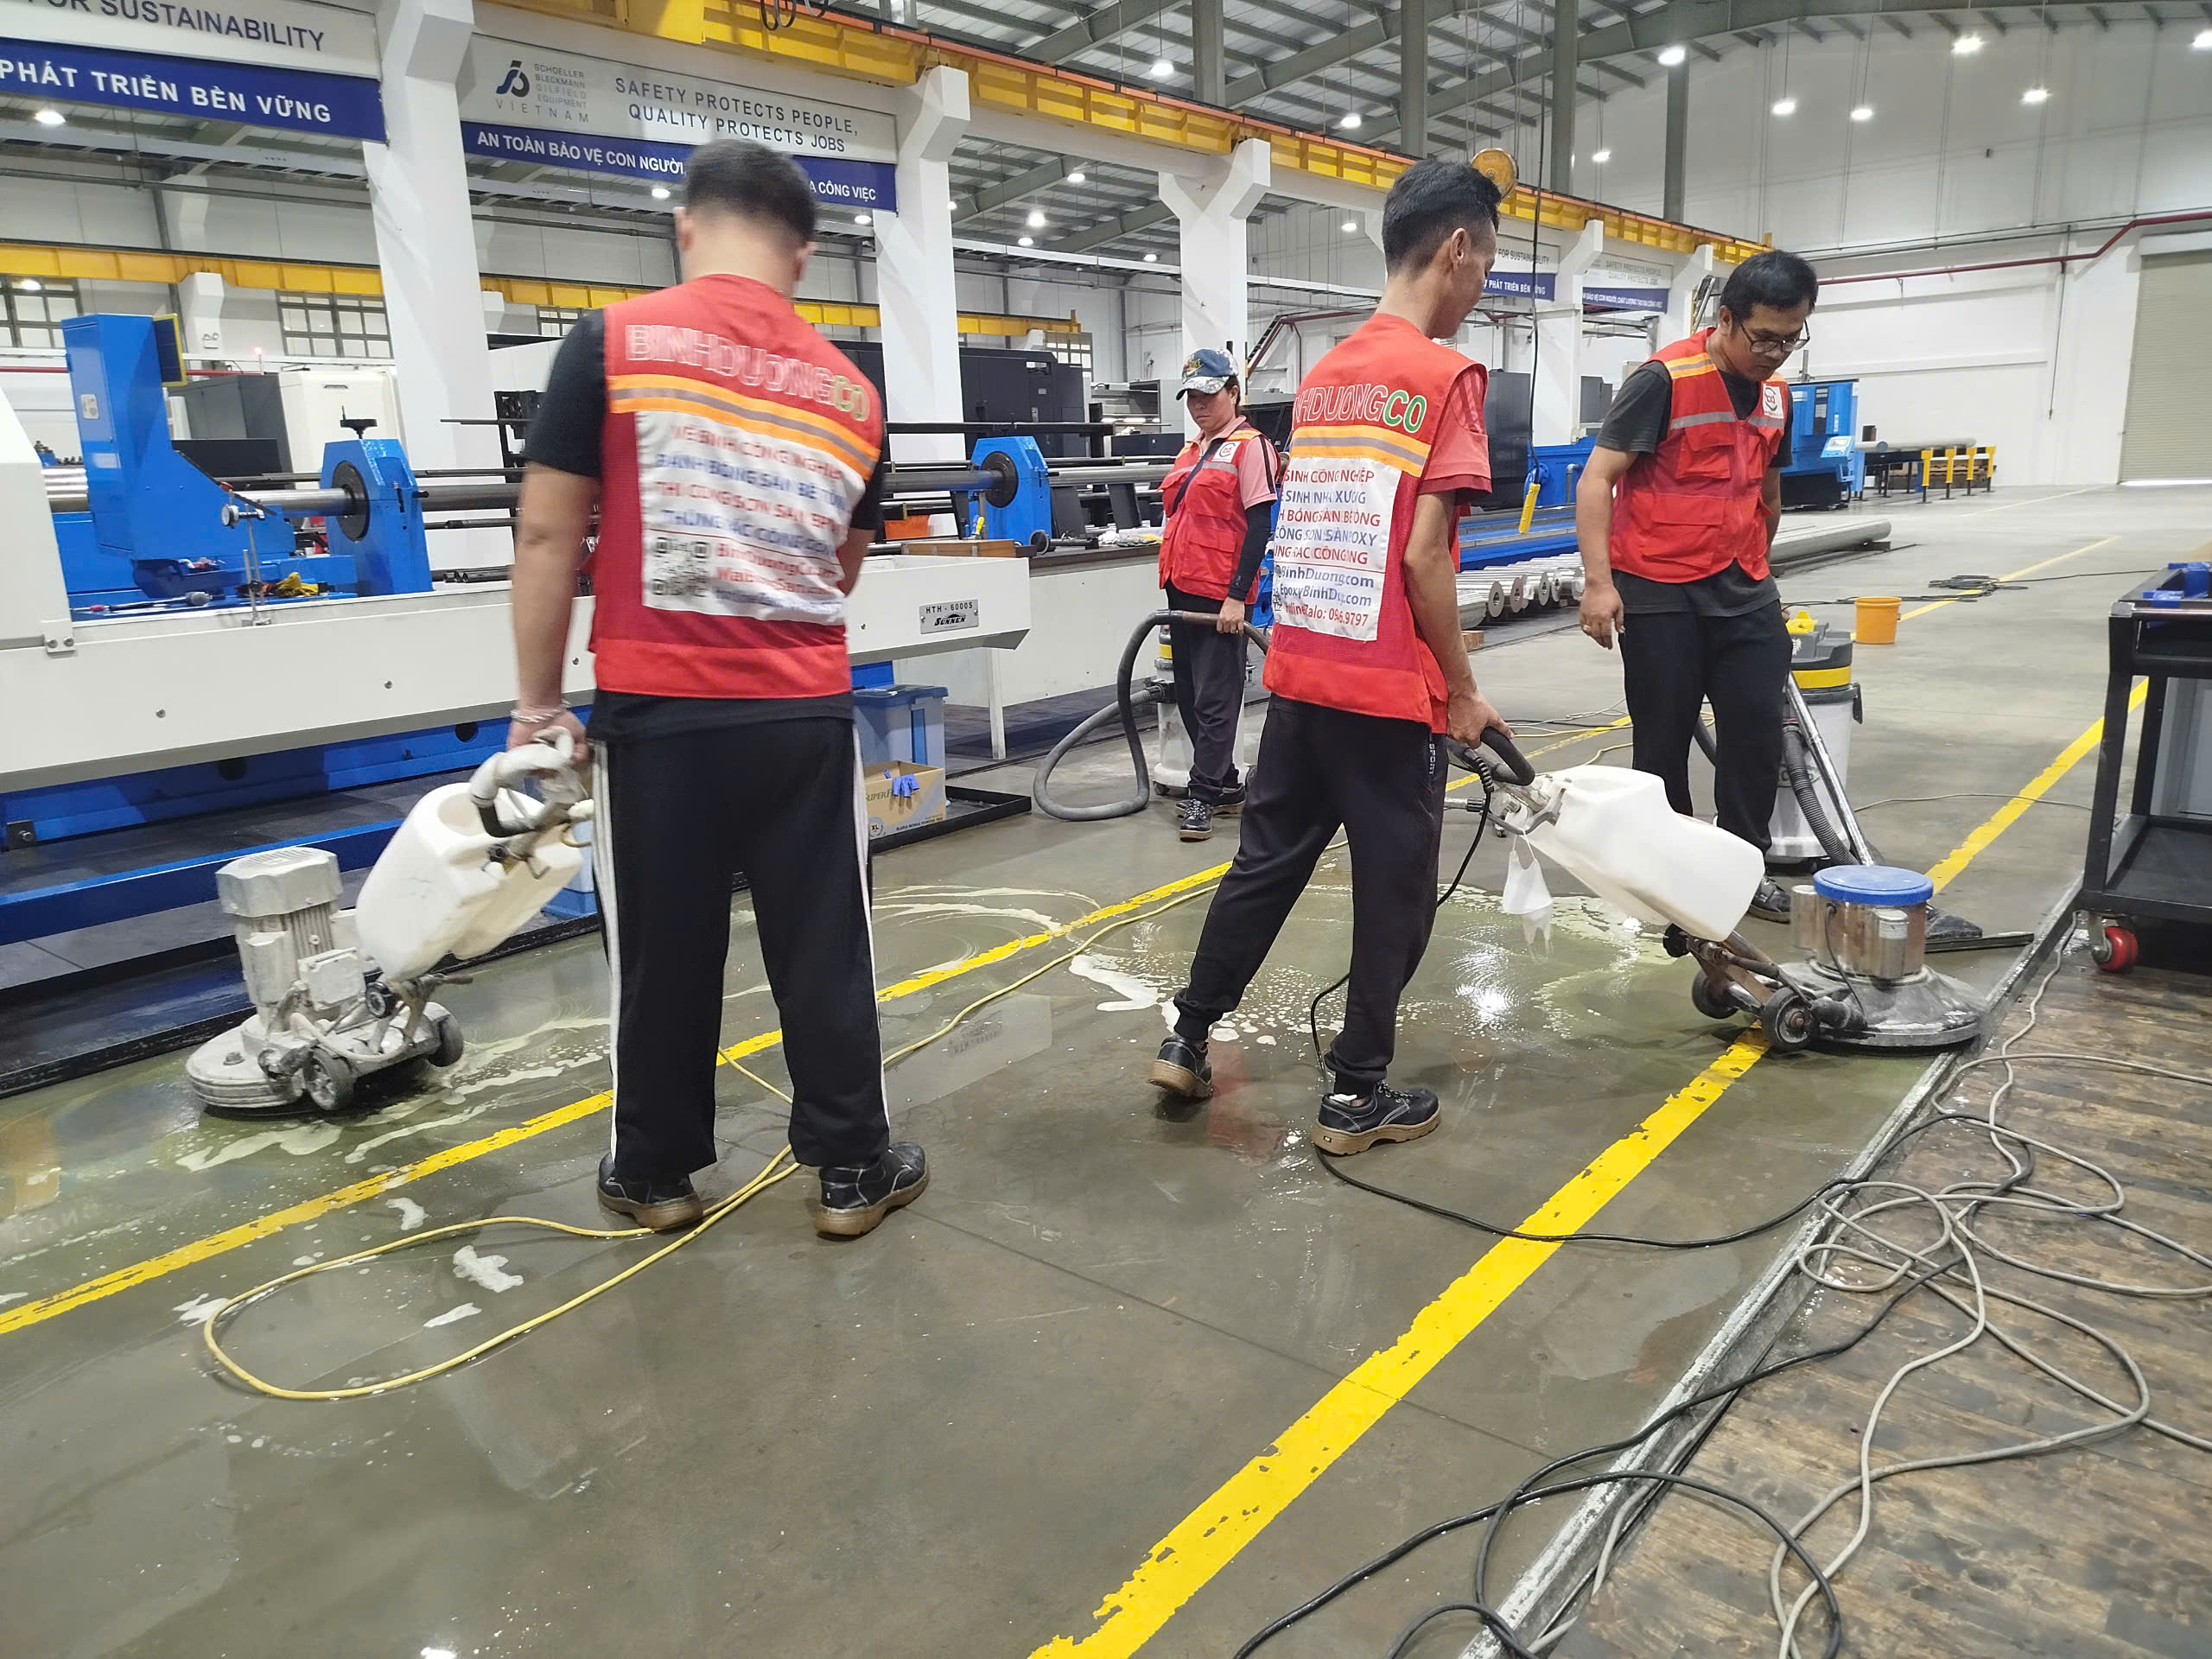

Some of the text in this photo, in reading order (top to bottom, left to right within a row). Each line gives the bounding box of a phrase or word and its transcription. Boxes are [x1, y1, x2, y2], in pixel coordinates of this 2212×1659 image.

[100, 0, 324, 51] SUSTAINABILITY
[534, 63, 584, 79] SCHOELLER
[0, 60, 78, 87] PHÁT
[256, 94, 331, 123] VỮNG
[615, 78, 858, 137] SAFETY PROTECTS PEOPLE,
[629, 104, 845, 152] QUALITY PROTECTS JOBS
[477, 131, 499, 148] AN
[503, 135, 545, 155] TOÀN
[549, 141, 581, 160] BẢO
[583, 148, 603, 166] VỆ
[607, 150, 637, 168] CON
[818, 180, 850, 197] CÔNG
[852, 186, 876, 201] VIỆC
[1286, 490, 1310, 504] SINH
[934, 615, 966, 626] SUNNEN
[950, 601, 973, 611] 6000S
